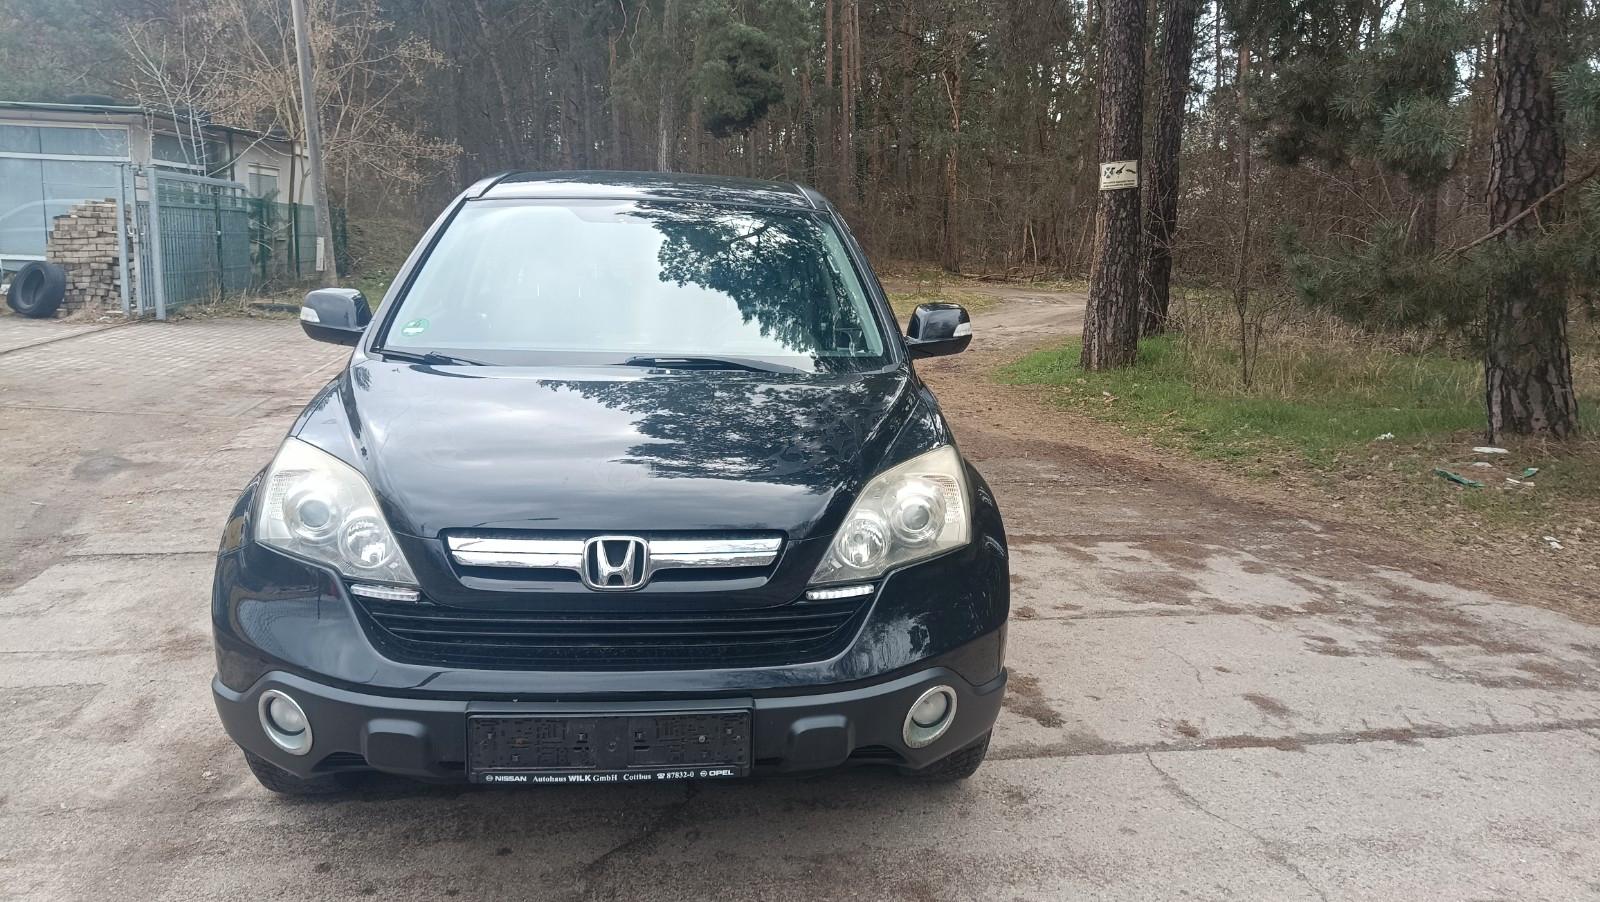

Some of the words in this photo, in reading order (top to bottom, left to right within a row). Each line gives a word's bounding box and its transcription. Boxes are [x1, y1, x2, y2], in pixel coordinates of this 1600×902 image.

[533, 775, 567, 783] Autohaus
[568, 774, 592, 782] WILK
[592, 774, 618, 782] GmbH
[623, 773, 652, 781] Cottbus
[666, 770, 695, 779] 87832-0
[709, 769, 734, 777] OPEL
